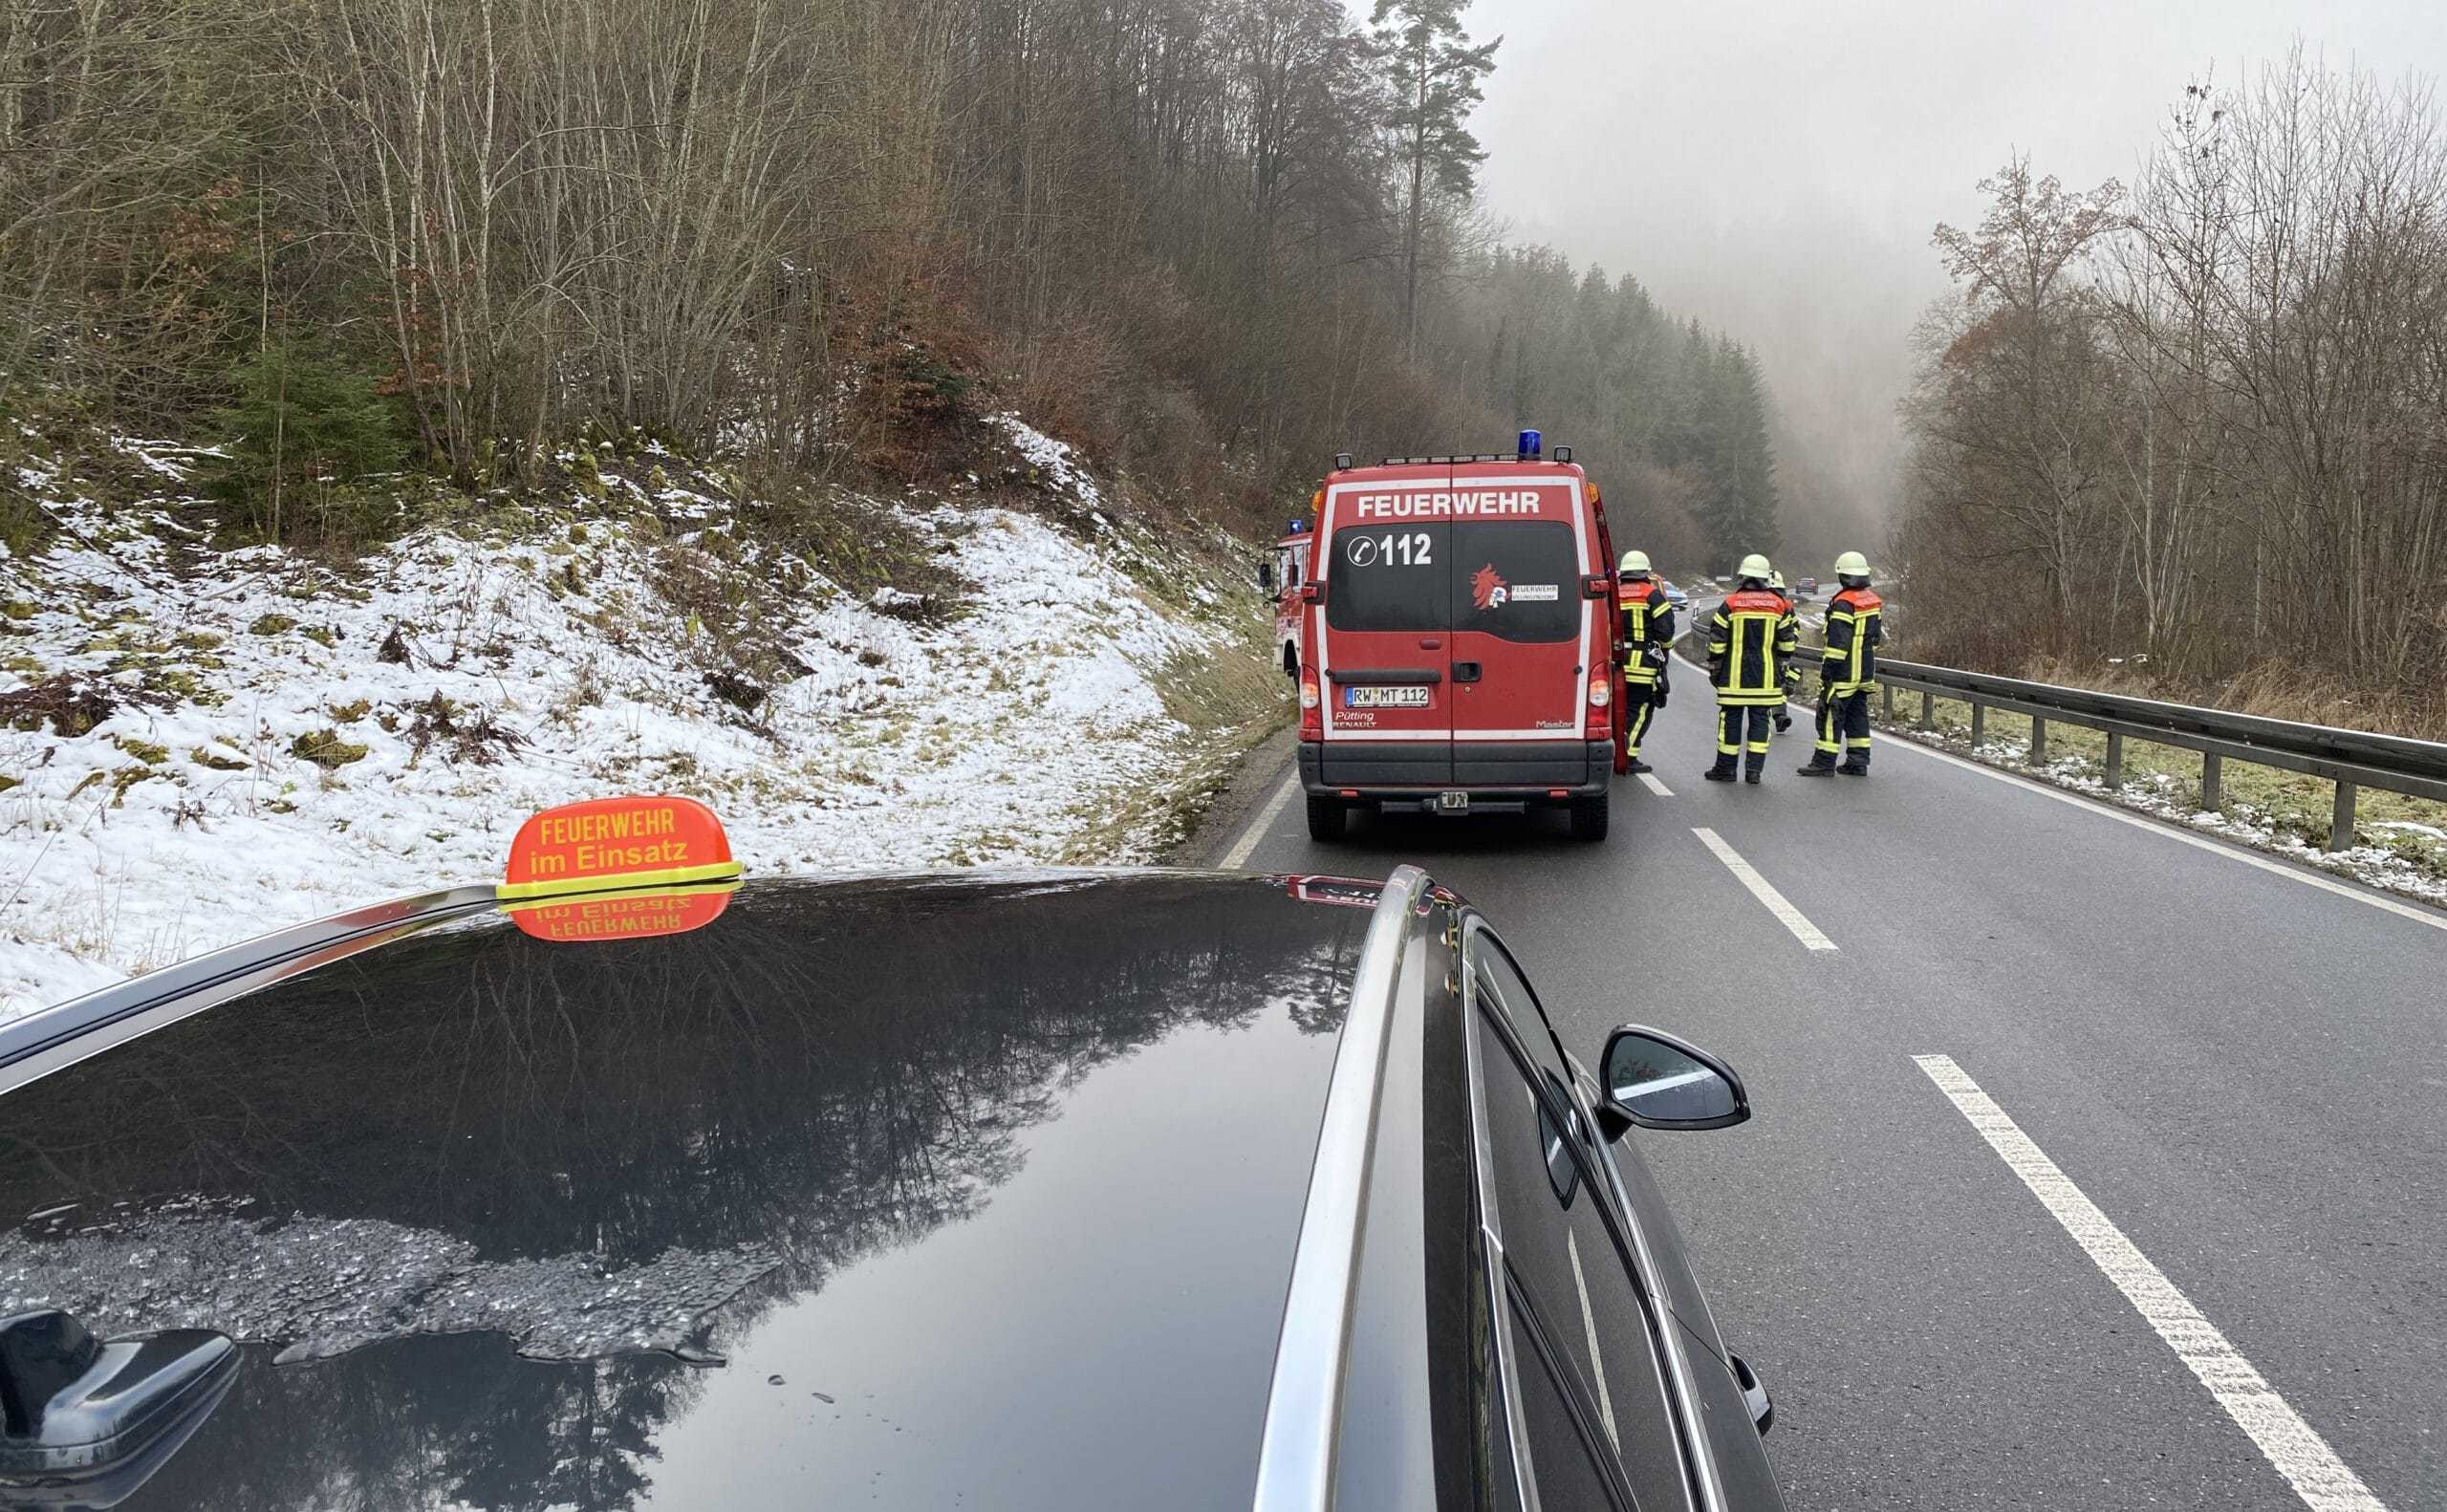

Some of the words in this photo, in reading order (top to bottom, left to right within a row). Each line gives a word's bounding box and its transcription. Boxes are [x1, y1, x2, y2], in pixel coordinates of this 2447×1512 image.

[1357, 491, 1540, 518] FEUERWEHR
[1380, 533, 1432, 566] 112
[1353, 689, 1372, 702] RW
[1380, 688, 1398, 702] MT
[1401, 688, 1427, 702] 112
[539, 808, 675, 846] FEUERWEHR
[531, 851, 566, 875] im
[576, 840, 689, 871] Einsatz
